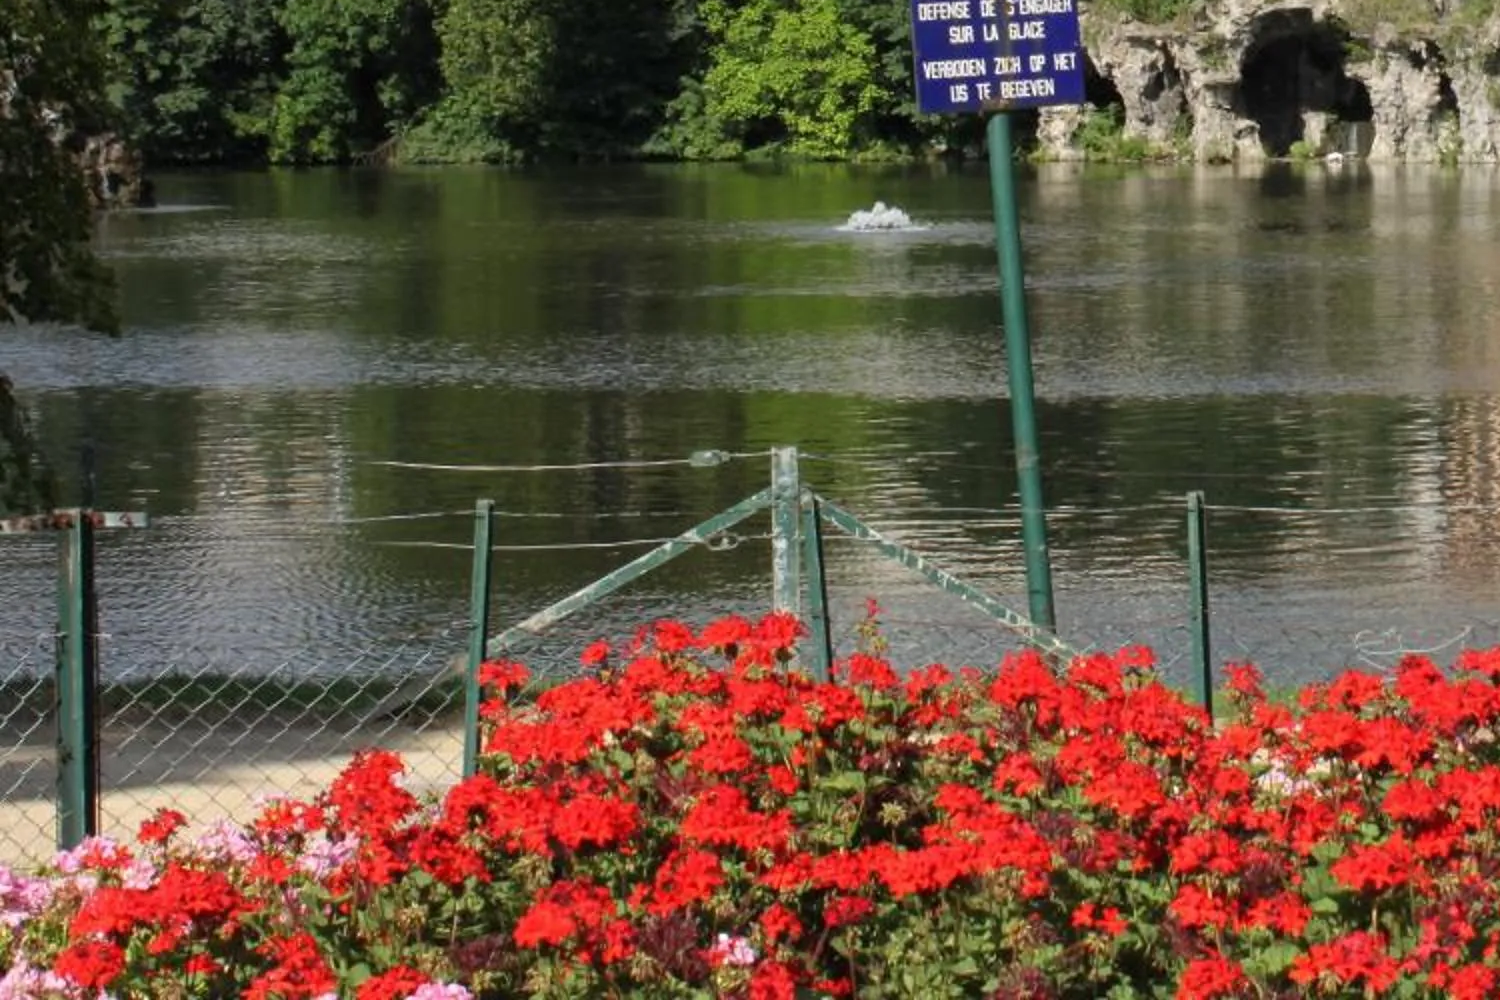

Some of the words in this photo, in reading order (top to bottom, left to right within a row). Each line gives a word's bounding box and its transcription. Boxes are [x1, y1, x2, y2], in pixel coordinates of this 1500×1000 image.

[919, 2, 970, 20] DEFENSE
[980, 0, 996, 16] DE
[949, 26, 974, 43] SUR
[983, 24, 999, 41] LA
[1008, 22, 1045, 39] GLACE
[923, 59, 986, 79] VERBODEN
[993, 56, 1021, 74] ZICH
[1030, 55, 1044, 72] OP
[1054, 53, 1075, 70] HET
[976, 83, 991, 100] TE
[1001, 79, 1054, 98] BEGEVEN
